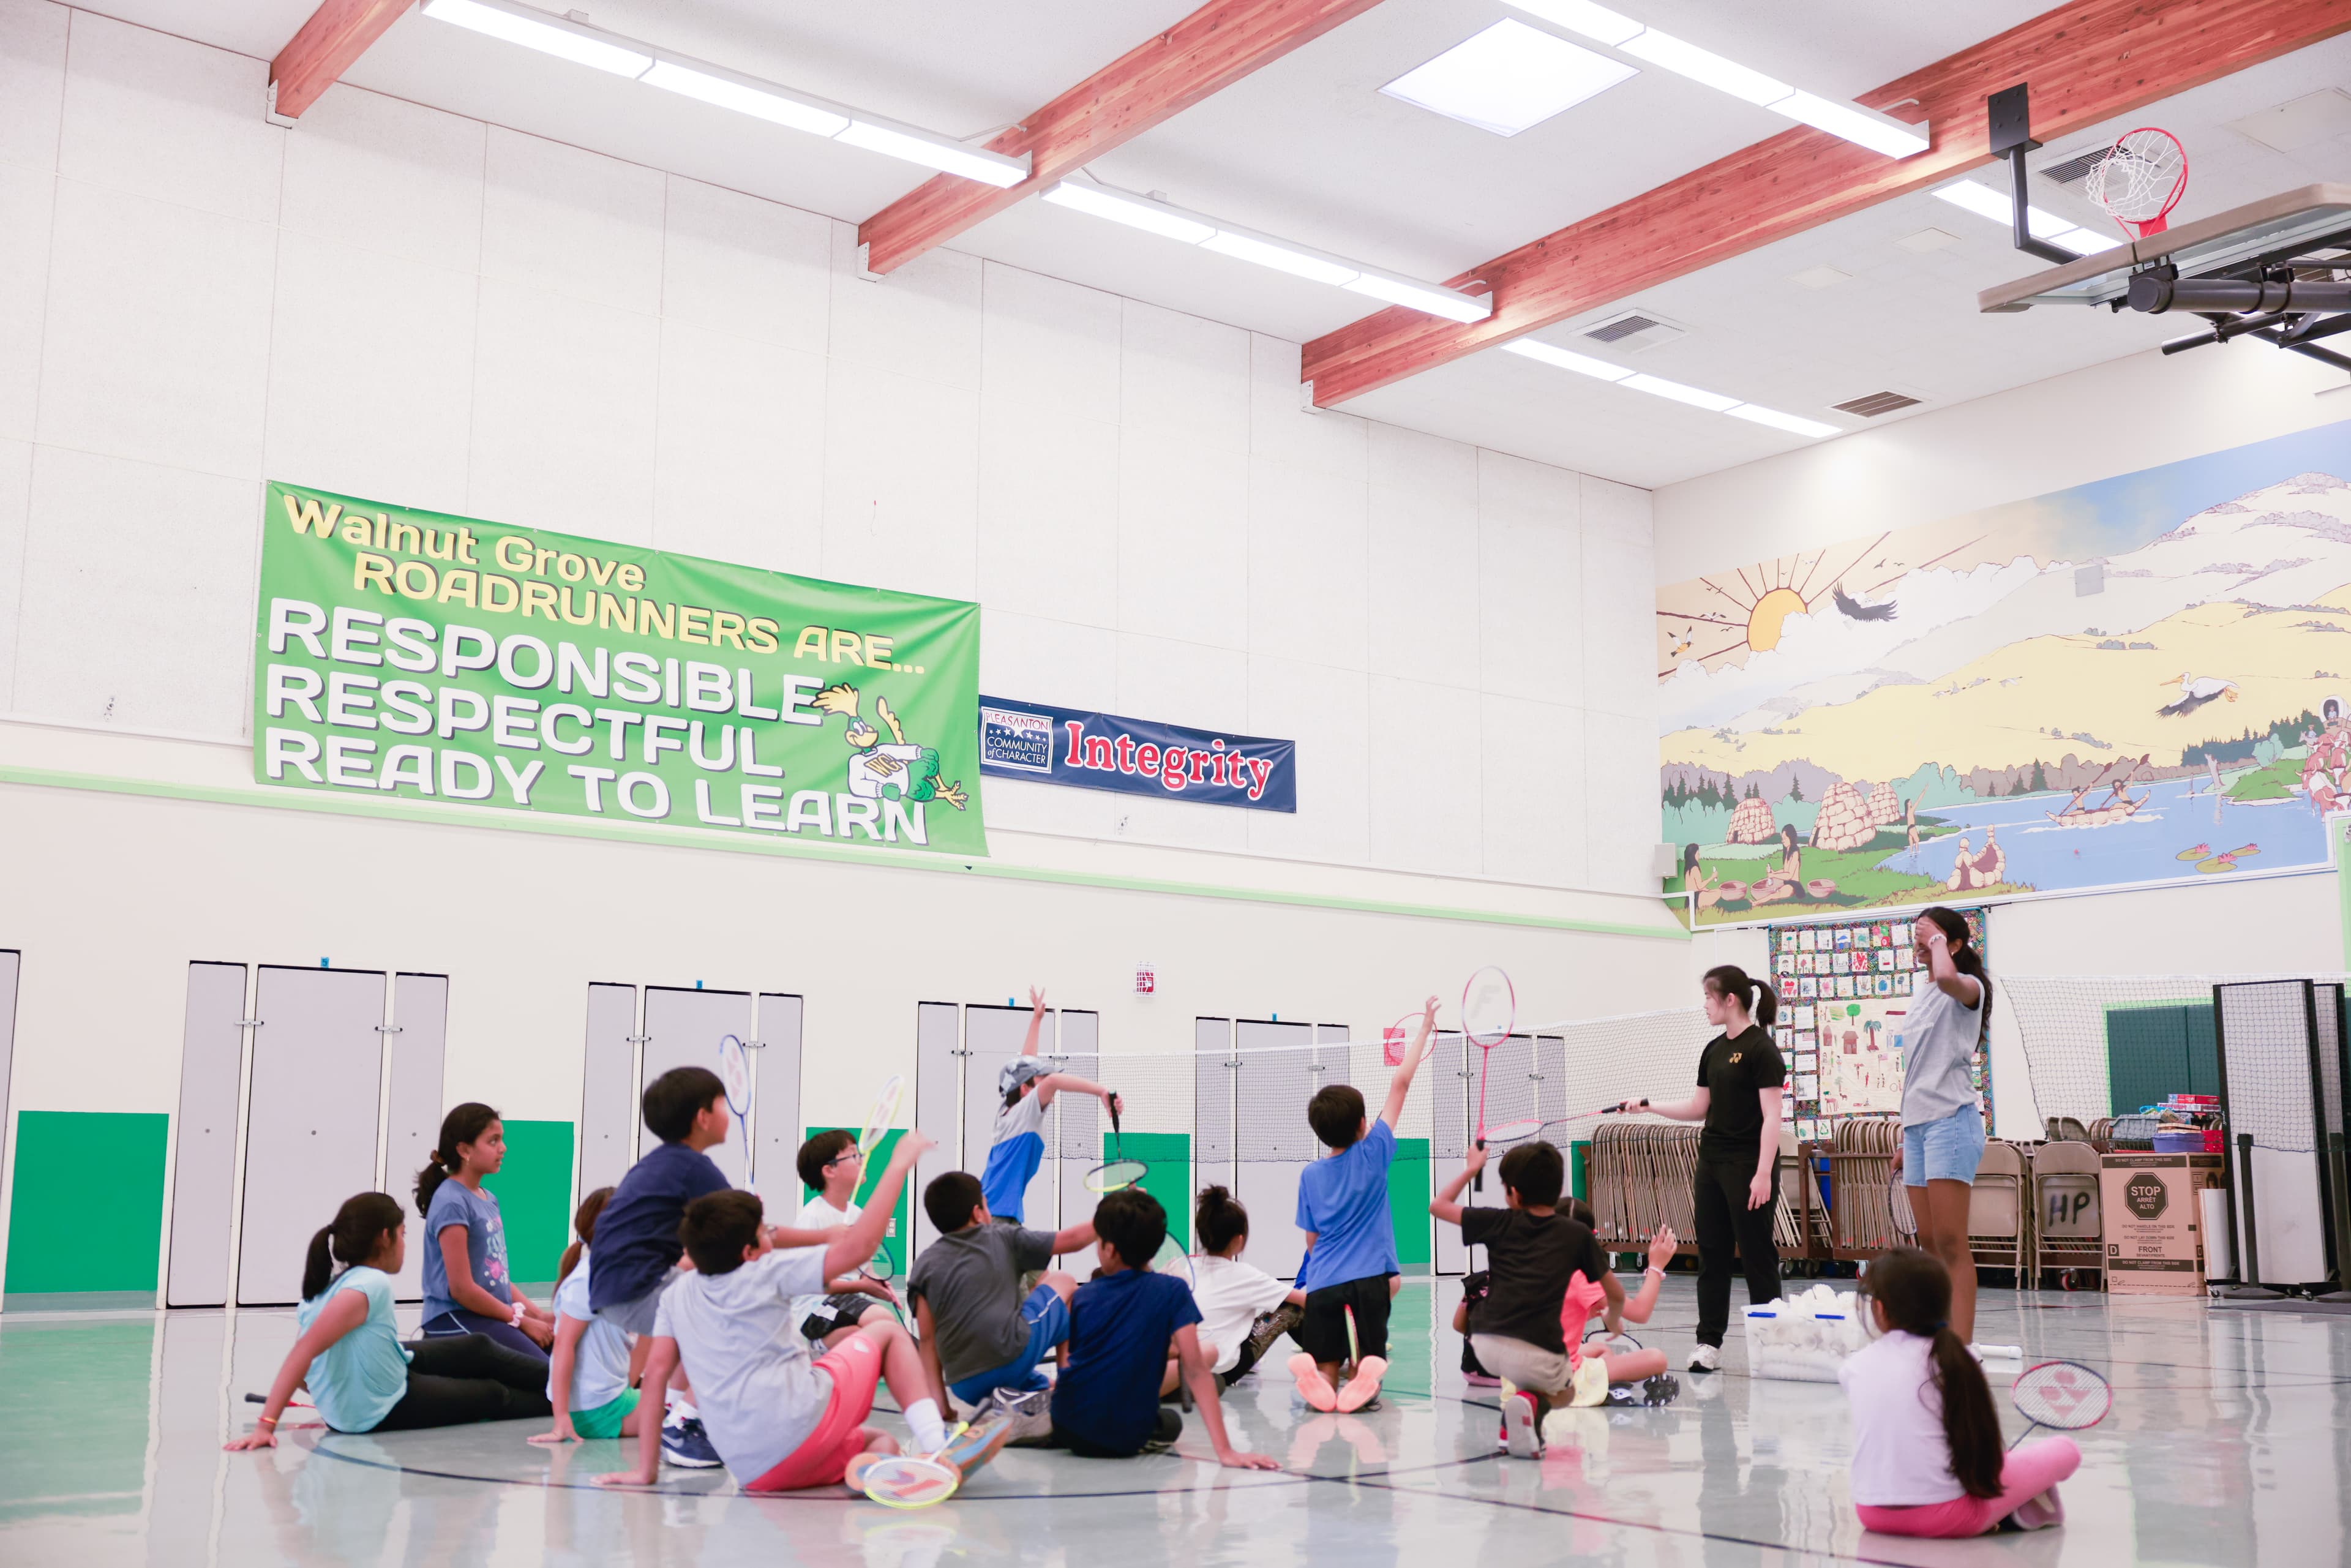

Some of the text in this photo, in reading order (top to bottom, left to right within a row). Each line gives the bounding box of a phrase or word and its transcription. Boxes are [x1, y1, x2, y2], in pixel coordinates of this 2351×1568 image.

[283, 495, 647, 591] Walnut Grove
[353, 552, 924, 674] ROADRUNNERS ARE...
[268, 597, 825, 726] RESPONSIBLE
[266, 663, 786, 778] RESPECTFUL
[986, 712, 1048, 730] PLEASANTON
[987, 737, 1047, 754] COMMUNITY
[988, 748, 1046, 764] of CHARACTER
[1064, 720, 1273, 801] Integrity
[863, 753, 903, 778] WG
[266, 727, 929, 846] READY TO LEARN
[2049, 1191, 2090, 1227] HP
[2131, 1186, 2161, 1196] STOP
[2110, 1245, 2117, 1255] D
